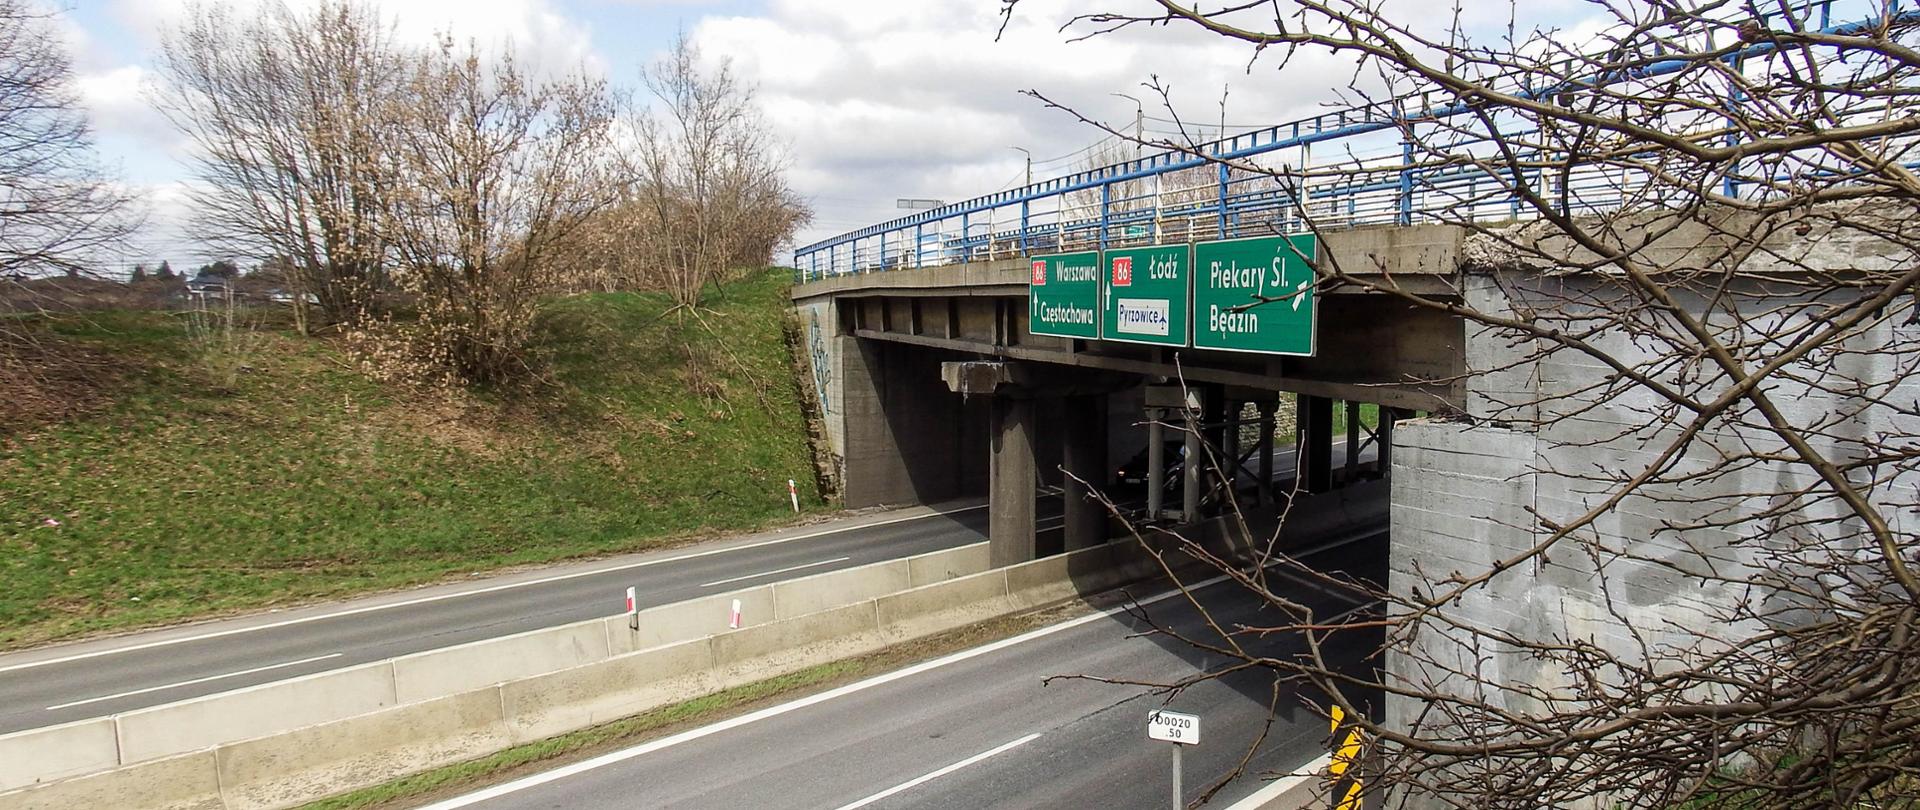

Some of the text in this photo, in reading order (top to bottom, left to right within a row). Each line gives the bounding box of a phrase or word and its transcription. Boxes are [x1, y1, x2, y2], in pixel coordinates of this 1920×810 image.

[1035, 261, 1096, 282] 86 Warszawa
[1117, 262, 1128, 280] 86
[1149, 253, 1178, 280] Łódź
[1211, 245, 1289, 294] Piekary Śl.
[1041, 302, 1093, 327] Częstochowa
[1119, 304, 1159, 328] Pyrzowice
[1210, 304, 1258, 339] Będzin
